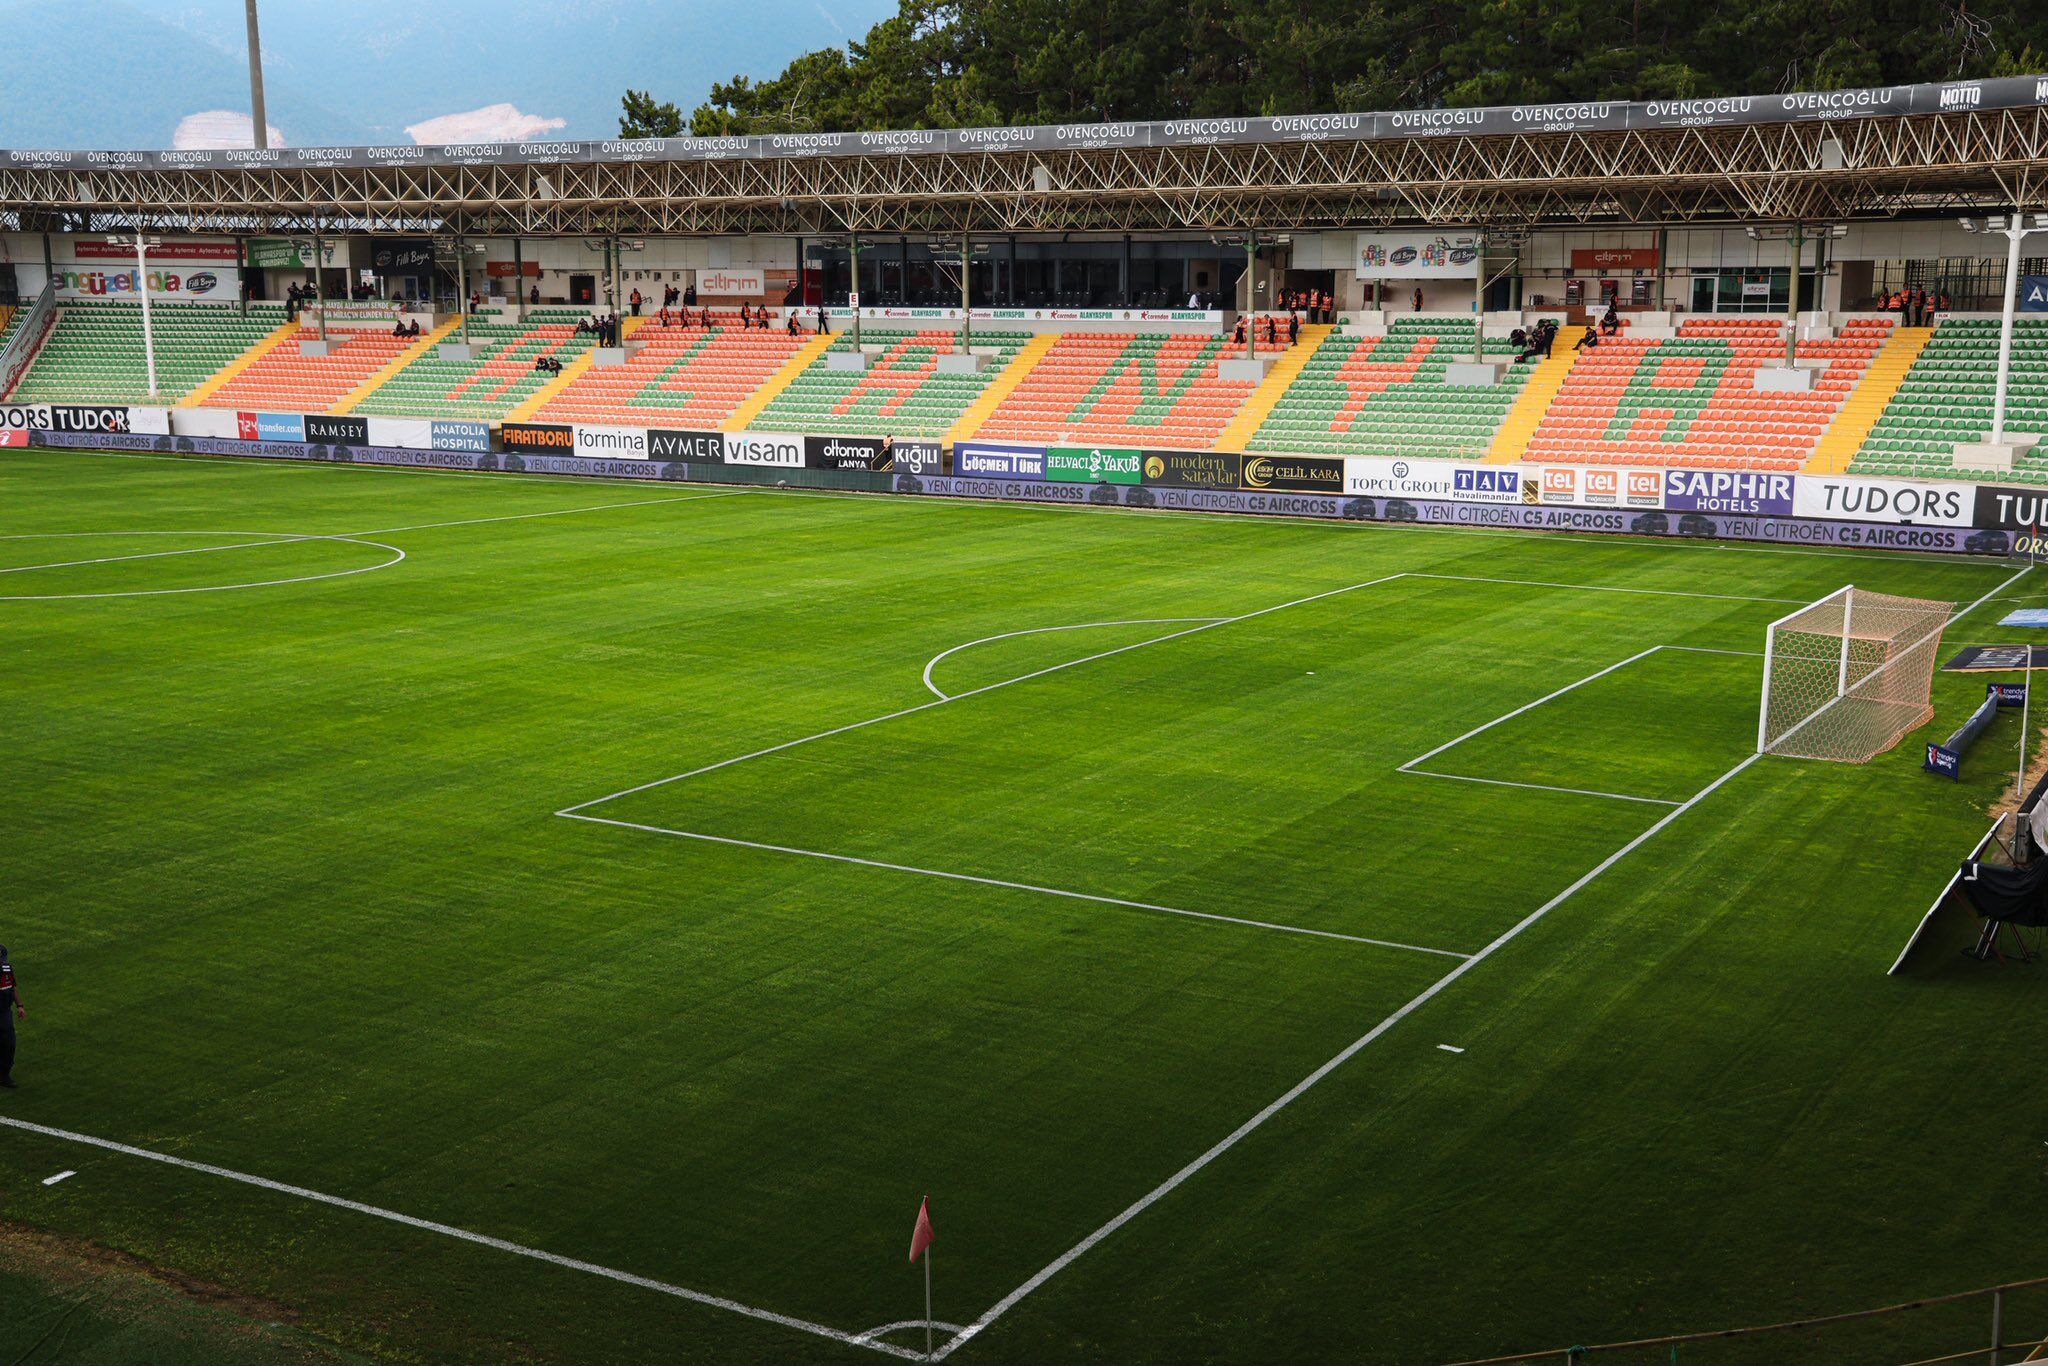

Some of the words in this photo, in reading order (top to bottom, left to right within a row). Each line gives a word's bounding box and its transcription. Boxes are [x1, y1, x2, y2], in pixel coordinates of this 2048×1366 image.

[1782, 89, 1892, 109] ÖVENÇOĞLU
[1940, 87, 1981, 107] MOTTO
[1512, 104, 1609, 122] ÖVENÇOĞLU
[1647, 98, 1750, 117] ÖVENÇOĞLU
[1818, 109, 1852, 118] GROUP
[1272, 116, 1359, 132] ÖVENÇOĞLU
[1392, 110, 1484, 128] ÖVENÇOĞLU
[1681, 117, 1713, 126] GROUP
[1057, 124, 1135, 139] ÖVENÇOĞLU
[1165, 120, 1247, 135] ÖVENÇOĞLU
[1422, 128, 1451, 136] GROUP
[1544, 123, 1574, 131] GROUP
[773, 135, 841, 149] ÖVENÇOĞLU
[861, 131, 933, 146] ÖVENÇOĞLU
[960, 128, 1034, 143] ÖVENÇOĞLU
[1192, 136, 1218, 144] GROUP
[1301, 132, 1328, 140] GROUP
[444, 145, 502, 158] ÖVENÇOĞLU
[519, 143, 580, 156] ÖVENÇOĞLU
[602, 141, 665, 154] ÖVENÇOĞLU
[683, 138, 749, 152] ÖVENÇOĞLU
[11, 151, 72, 163] ÖVENÇOĞLU
[87, 151, 143, 163] ÖVENÇOĞLU
[160, 151, 212, 163] ÖVENÇOĞLU
[226, 150, 279, 162] ÖVENÇOĞLU
[298, 149, 352, 161] ÖVENÇOĞLU
[368, 147, 424, 160] ÖVENÇOĞLU
[396, 251, 409, 266] Filli
[411, 250, 430, 266] Boya
[851, 294, 857, 302] E
[1080, 311, 1112, 319] ALANYASPOR
[1171, 312, 1206, 320] ALANYASPOR
[56, 409, 129, 431] TUDOR
[310, 423, 363, 438] RAMSEY
[433, 424, 486, 436] ANATOLIA
[49, 434, 66, 445] YENİ
[100, 436, 110, 446] C5
[111, 436, 150, 448] AIRCROSS
[433, 438, 486, 450] HOSPITAL
[503, 429, 573, 447] FIRATBORU
[578, 428, 644, 450] formina
[197, 440, 216, 452] YENİ
[251, 443, 262, 454] C5
[263, 443, 304, 456] AIRCROSS
[652, 437, 720, 457] AYMER
[728, 439, 799, 463] visam
[823, 440, 875, 458] ottoman
[356, 449, 375, 461] YENİ
[415, 453, 426, 464] C5
[428, 453, 473, 466] AIRCROSS
[838, 460, 867, 469] LANYA
[962, 450, 1009, 472] GÖÇMEN
[1009, 452, 1042, 473] TÜRK
[1048, 455, 1089, 470] HELVACI
[1102, 455, 1140, 473] YAKUB
[1171, 454, 1225, 471] modern
[529, 457, 549, 471] YENİ
[552, 459, 591, 472] CITROËN
[593, 462, 606, 473] C5
[608, 463, 656, 476] AIRCROSS
[1276, 466, 1307, 479] CELİL
[1310, 468, 1340, 480] KARA
[1182, 468, 1237, 486] saraylar
[1457, 471, 1516, 490] TAV
[927, 477, 951, 492] YENİ
[954, 480, 1002, 495] CITROËN
[1005, 483, 1021, 496] C5
[1023, 484, 1083, 500] AIRCROSS
[1351, 478, 1398, 492] TOPCU
[1401, 480, 1451, 494] GROUP
[1160, 489, 1187, 506] YENİ
[1191, 493, 1245, 509] CITROËN
[1249, 496, 1266, 510] C5
[1269, 497, 1336, 514] AIRCROSS
[1453, 491, 1517, 502] Havalimanları
[1824, 485, 1961, 519] TUDORS
[1697, 498, 1759, 512] HOTELS
[1424, 503, 1454, 520] YENİ
[1458, 506, 1520, 524] CITROËN
[1524, 510, 1542, 525] C5
[1546, 511, 1623, 530] AIRCROSS
[1724, 518, 1759, 536] YENİ
[1763, 521, 1834, 540] CITROËN
[1839, 527, 1861, 542] C5
[1866, 528, 1956, 549] AIRCROSS
